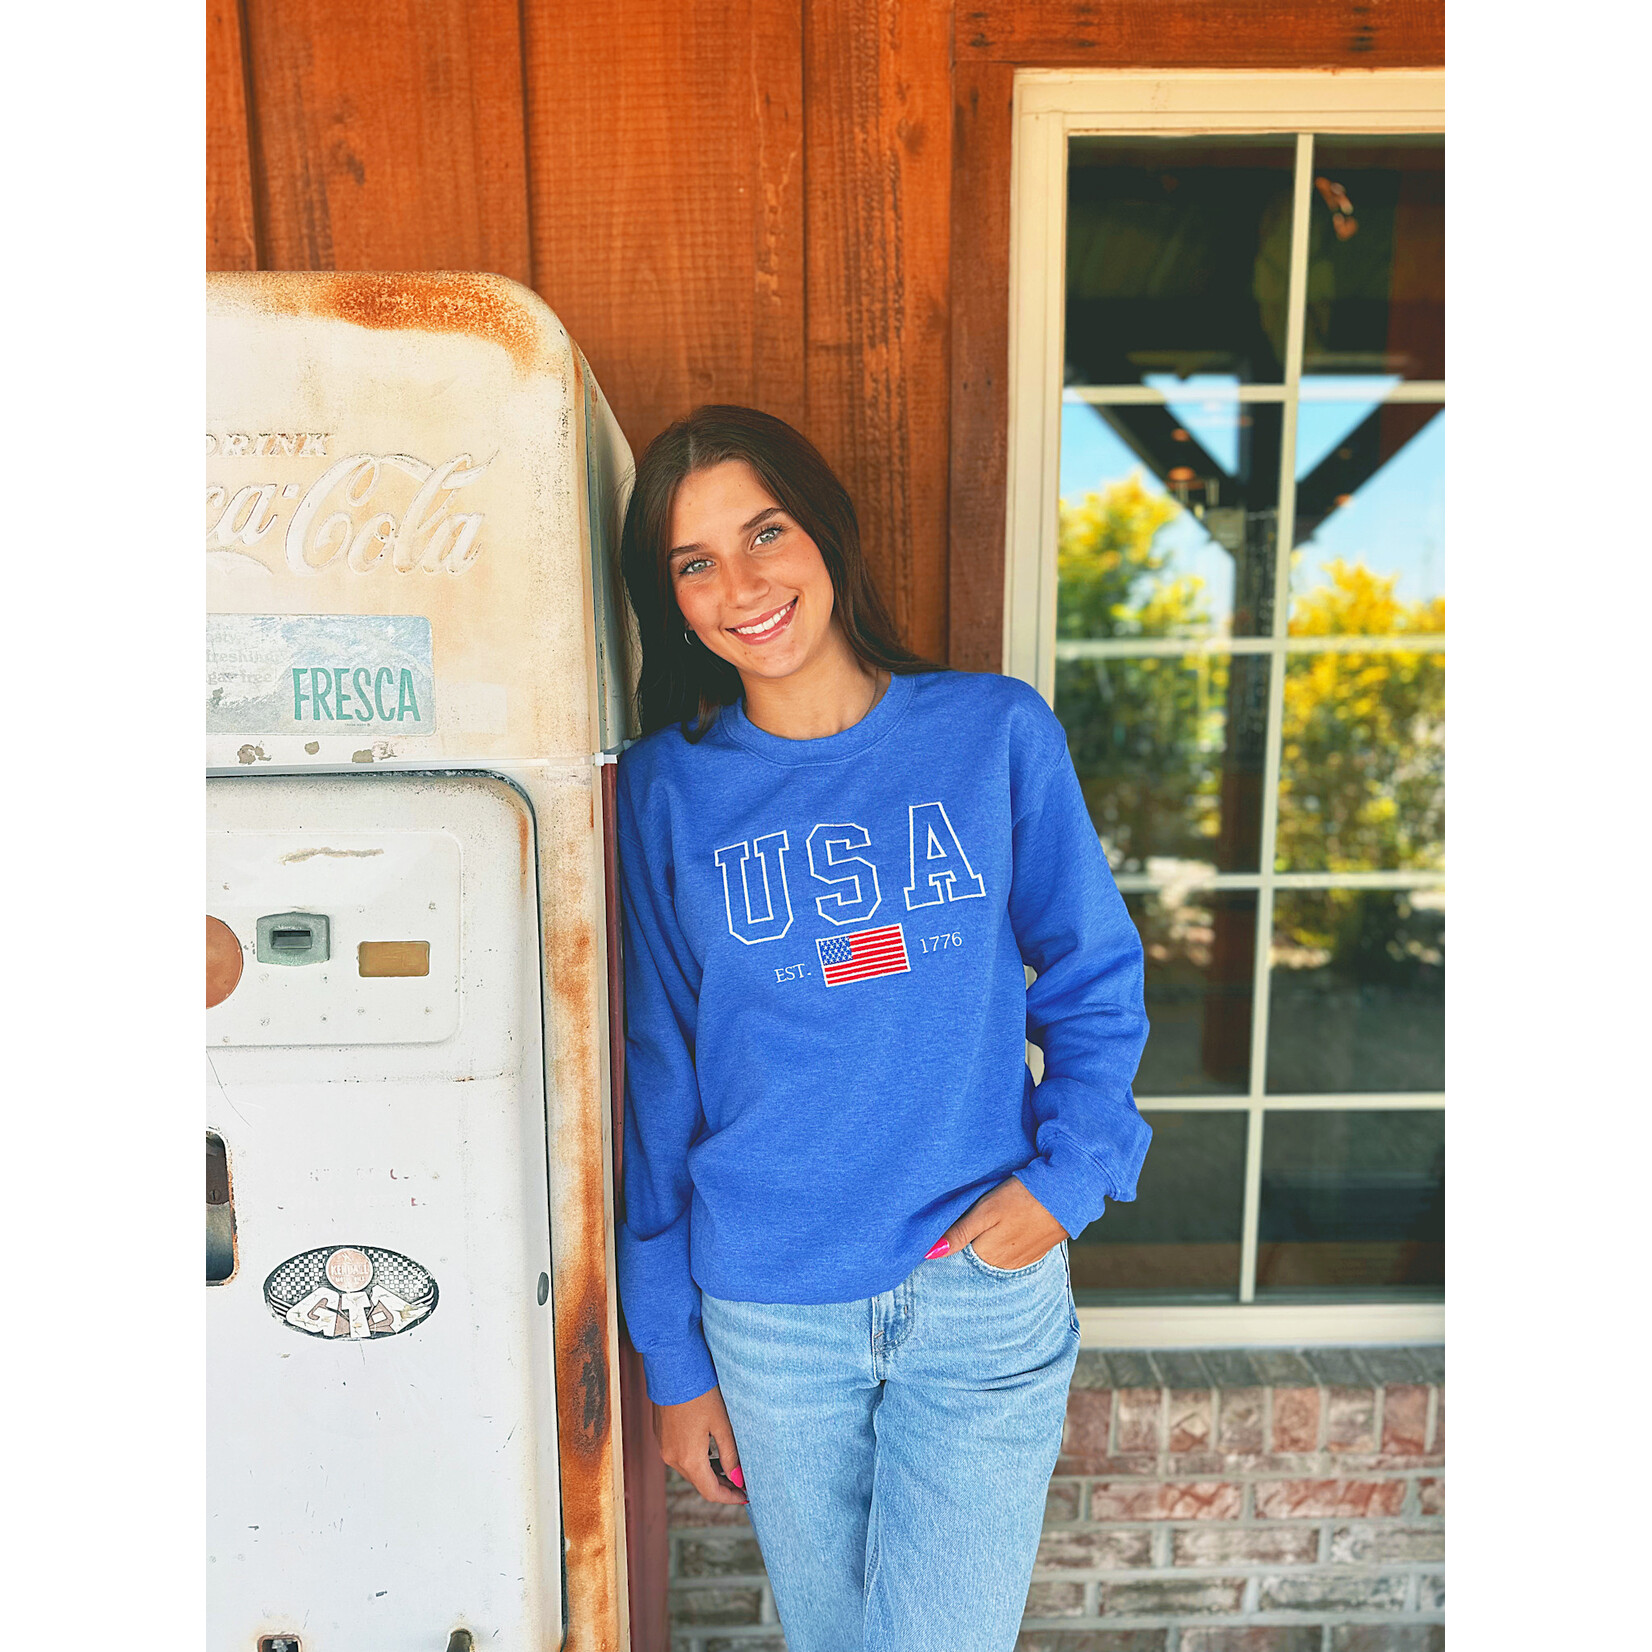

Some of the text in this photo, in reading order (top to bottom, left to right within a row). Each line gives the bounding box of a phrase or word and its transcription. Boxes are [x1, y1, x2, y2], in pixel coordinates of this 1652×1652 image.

[292, 666, 421, 722] FRESCA
[714, 801, 986, 945] USA
[774, 931, 963, 984] EST. 1776
